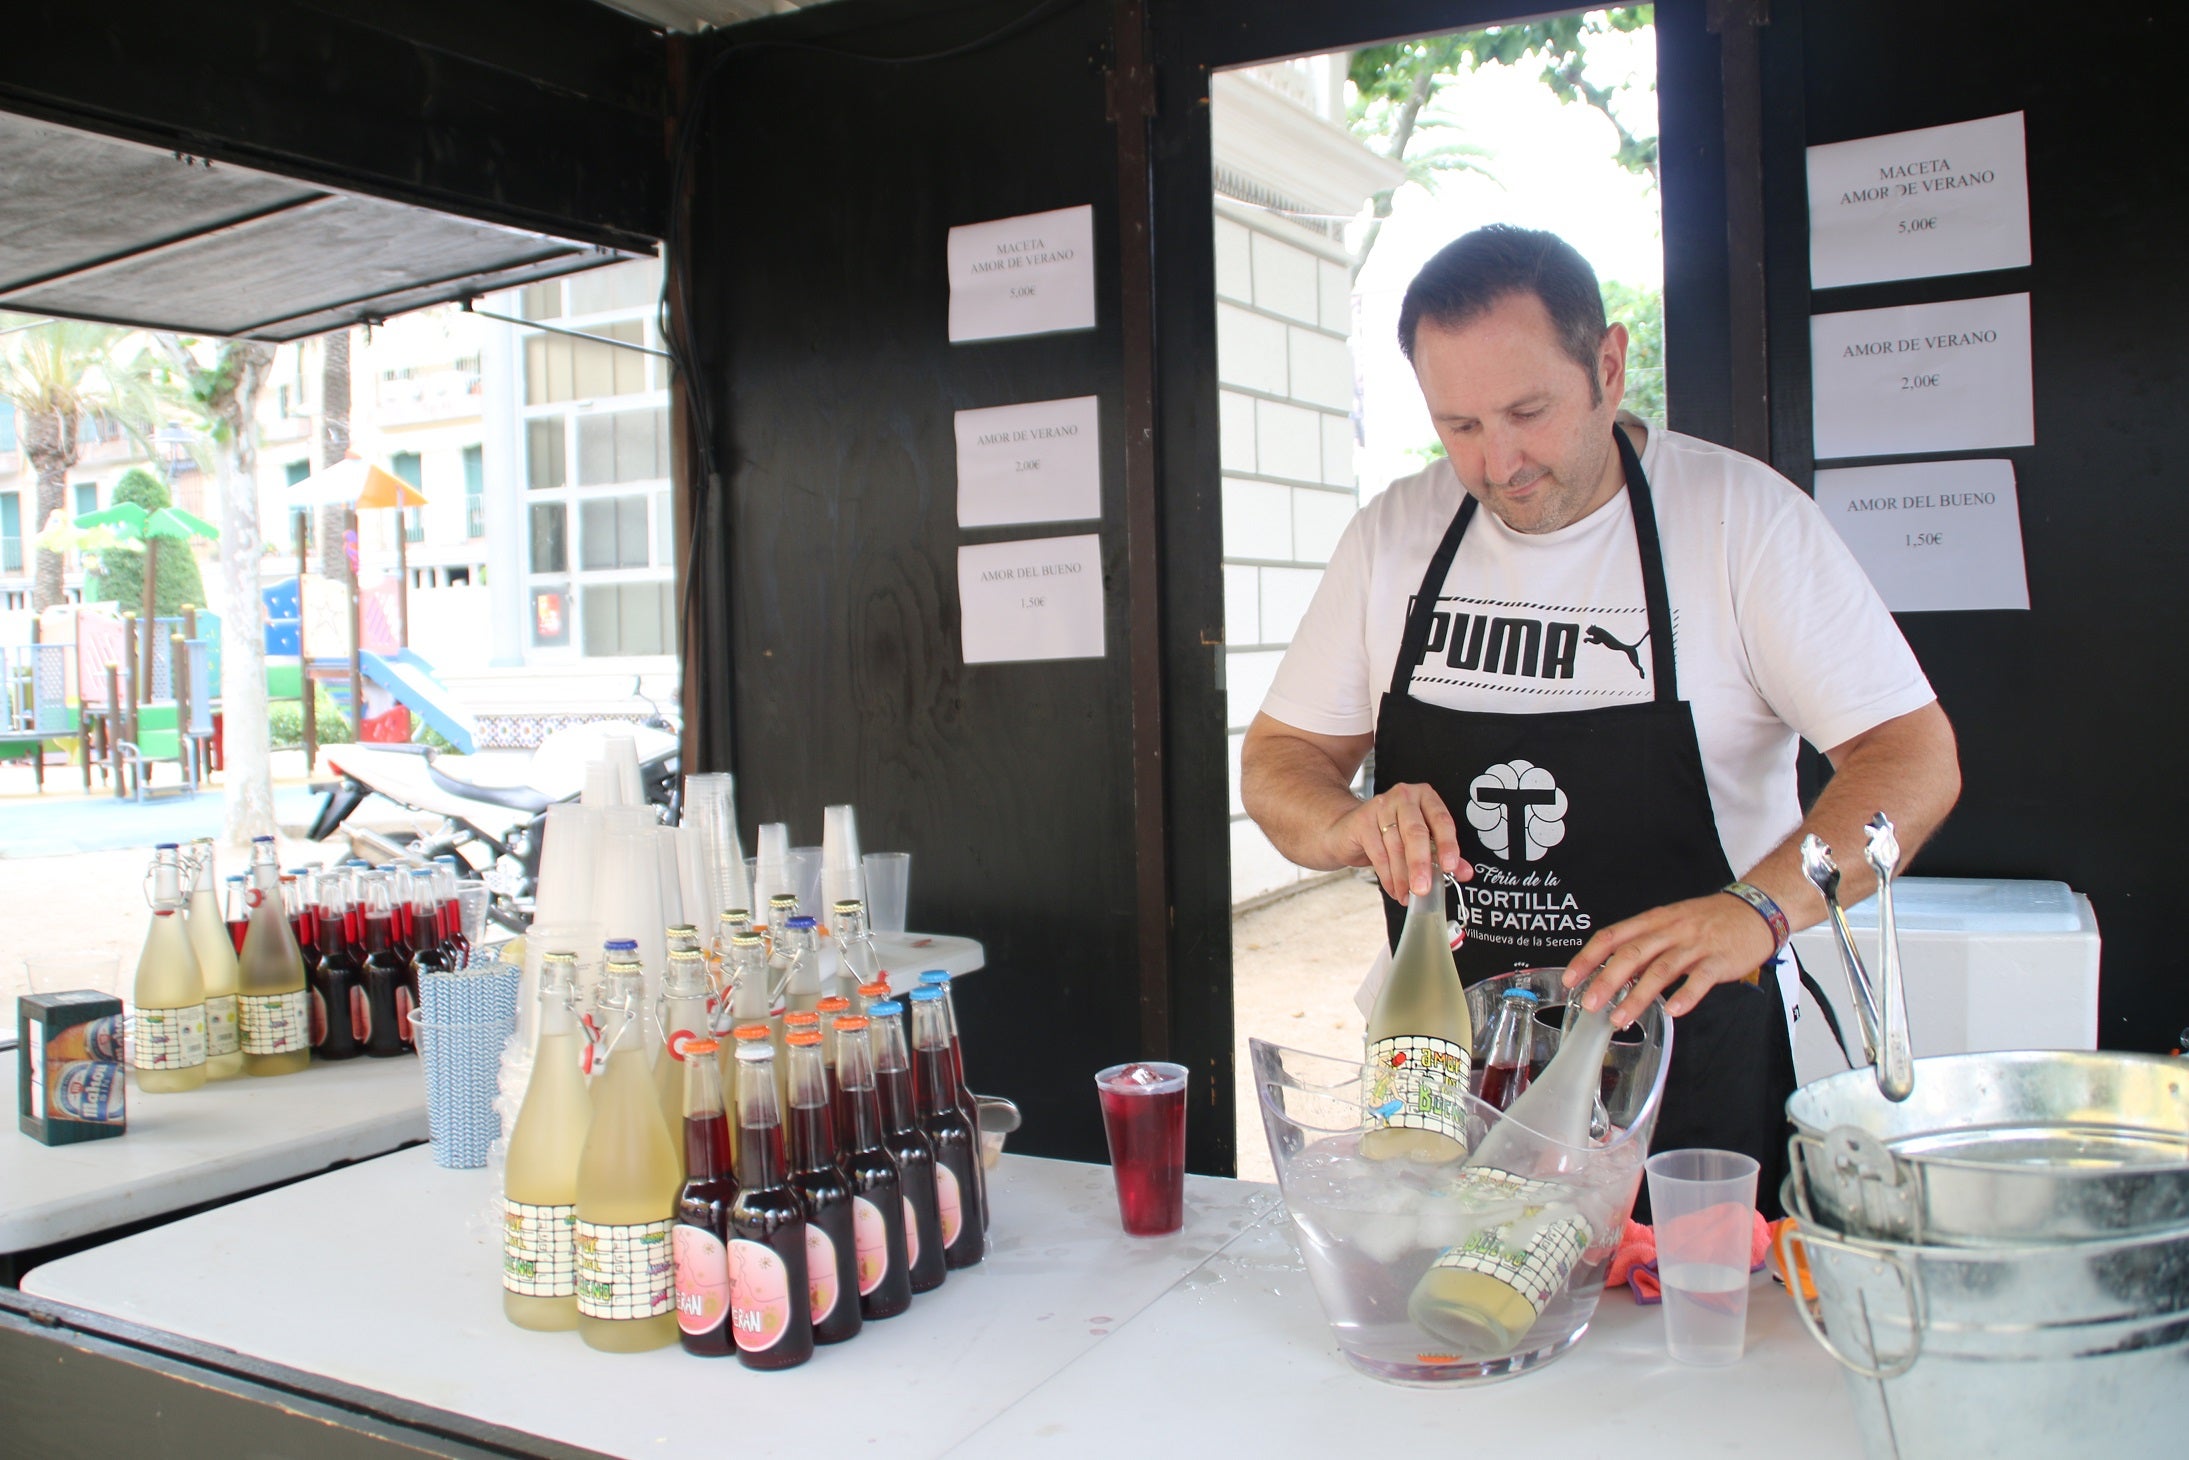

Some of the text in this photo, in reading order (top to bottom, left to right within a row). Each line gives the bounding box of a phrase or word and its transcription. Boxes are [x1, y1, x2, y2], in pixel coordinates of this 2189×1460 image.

[1879, 159, 1951, 181] MACETA
[1840, 170, 1995, 205] AMOR DE VERANO
[1898, 216, 1938, 234] 5,00€
[996, 238, 1045, 255] MACETA
[970, 249, 1074, 274] AMOR DE VERANO
[1009, 285, 1036, 298] 5,00€
[1842, 329, 1998, 358] AMOR DE VERANO
[1901, 373, 1940, 391] 2,00€
[977, 424, 1079, 446] AMOR DE VERANO
[1015, 459, 1041, 472] 2,00€
[1847, 492, 1996, 512] AMOR DEL BUENO
[1905, 532, 1944, 548] 1,50€
[980, 562, 1083, 582] AMOR DEL BUENO
[1021, 596, 1045, 609] 1,50€
[1415, 611, 1580, 680] PUMA
[1474, 863, 1561, 887] Feria de la
[1465, 886, 1579, 910] TORTILLA
[1457, 903, 1592, 931] DE PATATAS
[1464, 928, 1583, 947] Villanueva de la Serena
[732, 1308, 762, 1333] ERAN
